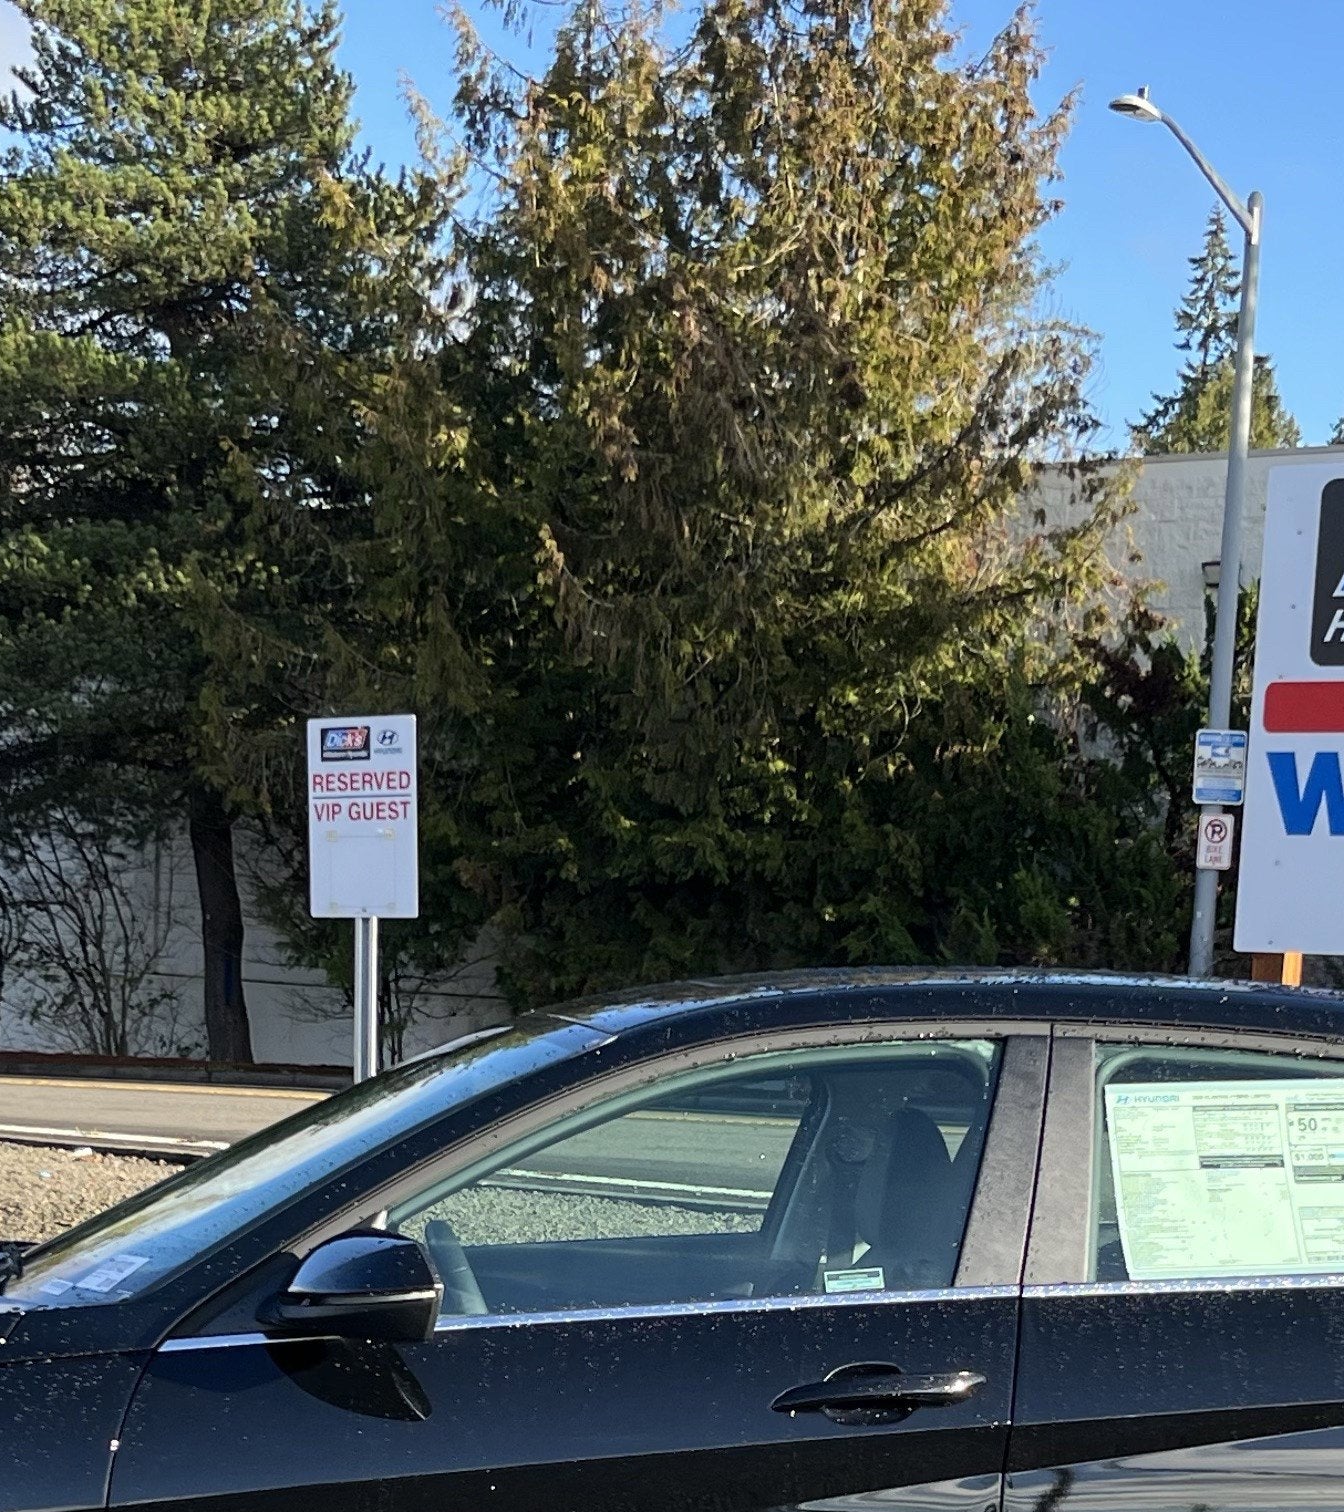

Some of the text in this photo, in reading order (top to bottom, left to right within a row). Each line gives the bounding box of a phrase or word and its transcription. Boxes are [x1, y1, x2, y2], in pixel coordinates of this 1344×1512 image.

[312, 771, 411, 793] RESERVED
[314, 801, 411, 822] VIP GUEST
[1298, 1118, 1317, 1131] 50
